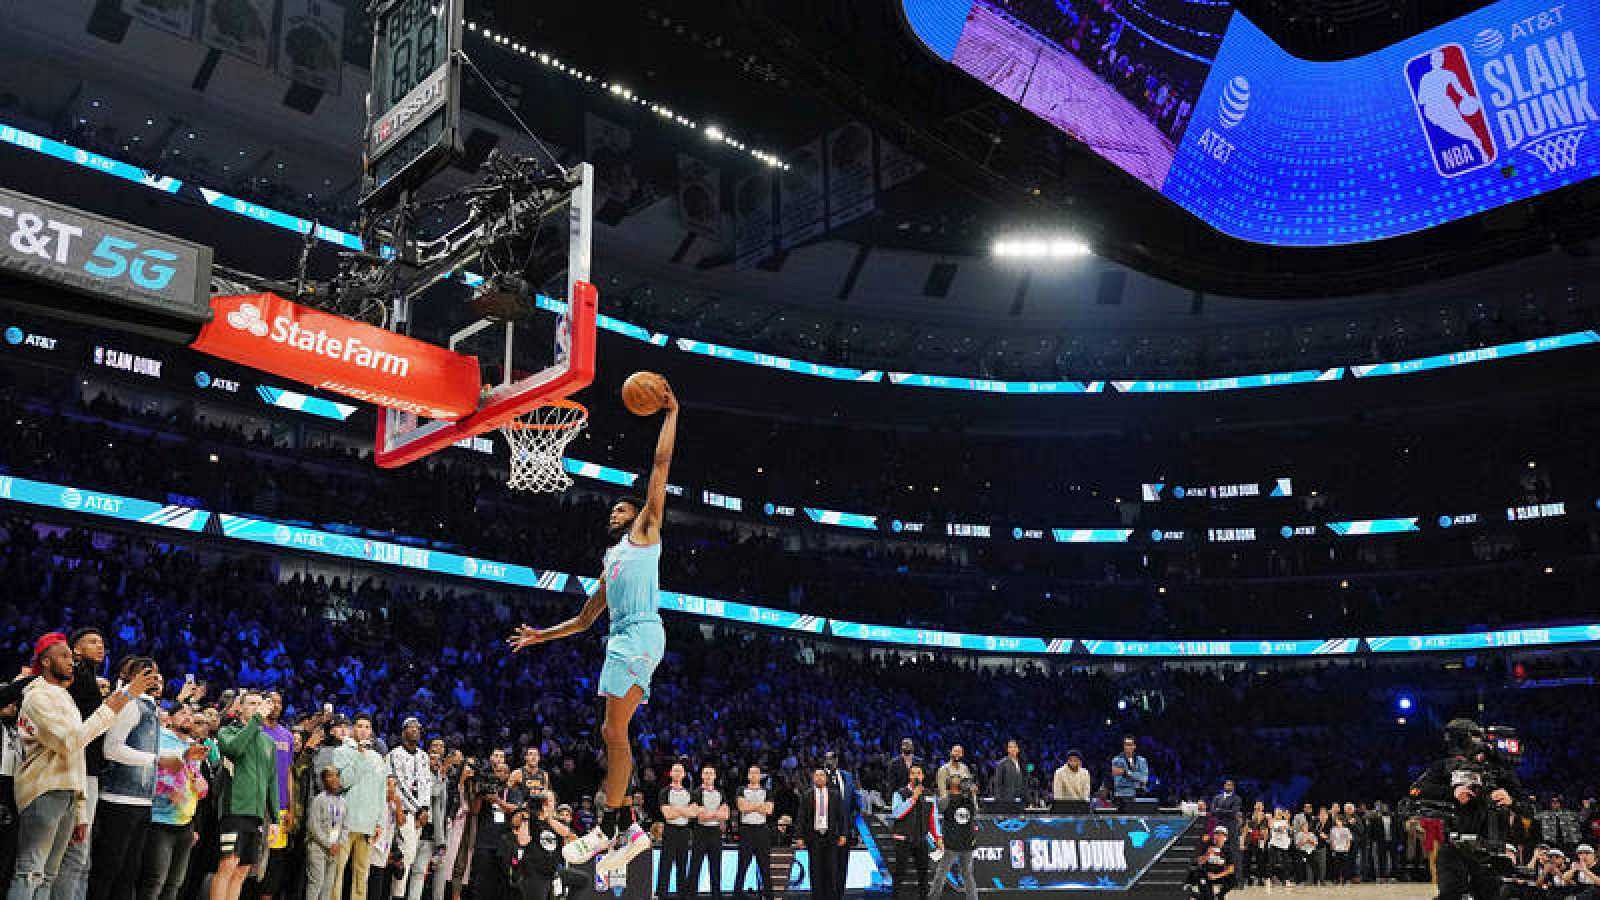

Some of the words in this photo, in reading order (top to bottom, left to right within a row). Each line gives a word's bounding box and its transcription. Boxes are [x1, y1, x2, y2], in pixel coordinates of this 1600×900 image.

[1511, 4, 1566, 41] AT&T
[1483, 31, 1586, 107] SLAM
[1496, 80, 1600, 149] DUNK
[1198, 128, 1234, 165] AT&T
[1441, 143, 1475, 169] NBA
[83, 235, 177, 290] 5G
[25, 334, 57, 350] AT&T
[212, 377, 240, 393] AT&T
[84, 495, 122, 513] AT&T
[293, 531, 324, 546] AT&T
[479, 564, 507, 577] AT&T
[972, 847, 1005, 861] AT&T
[1031, 839, 1076, 871] SLAM
[1079, 839, 1127, 871] DUNK
